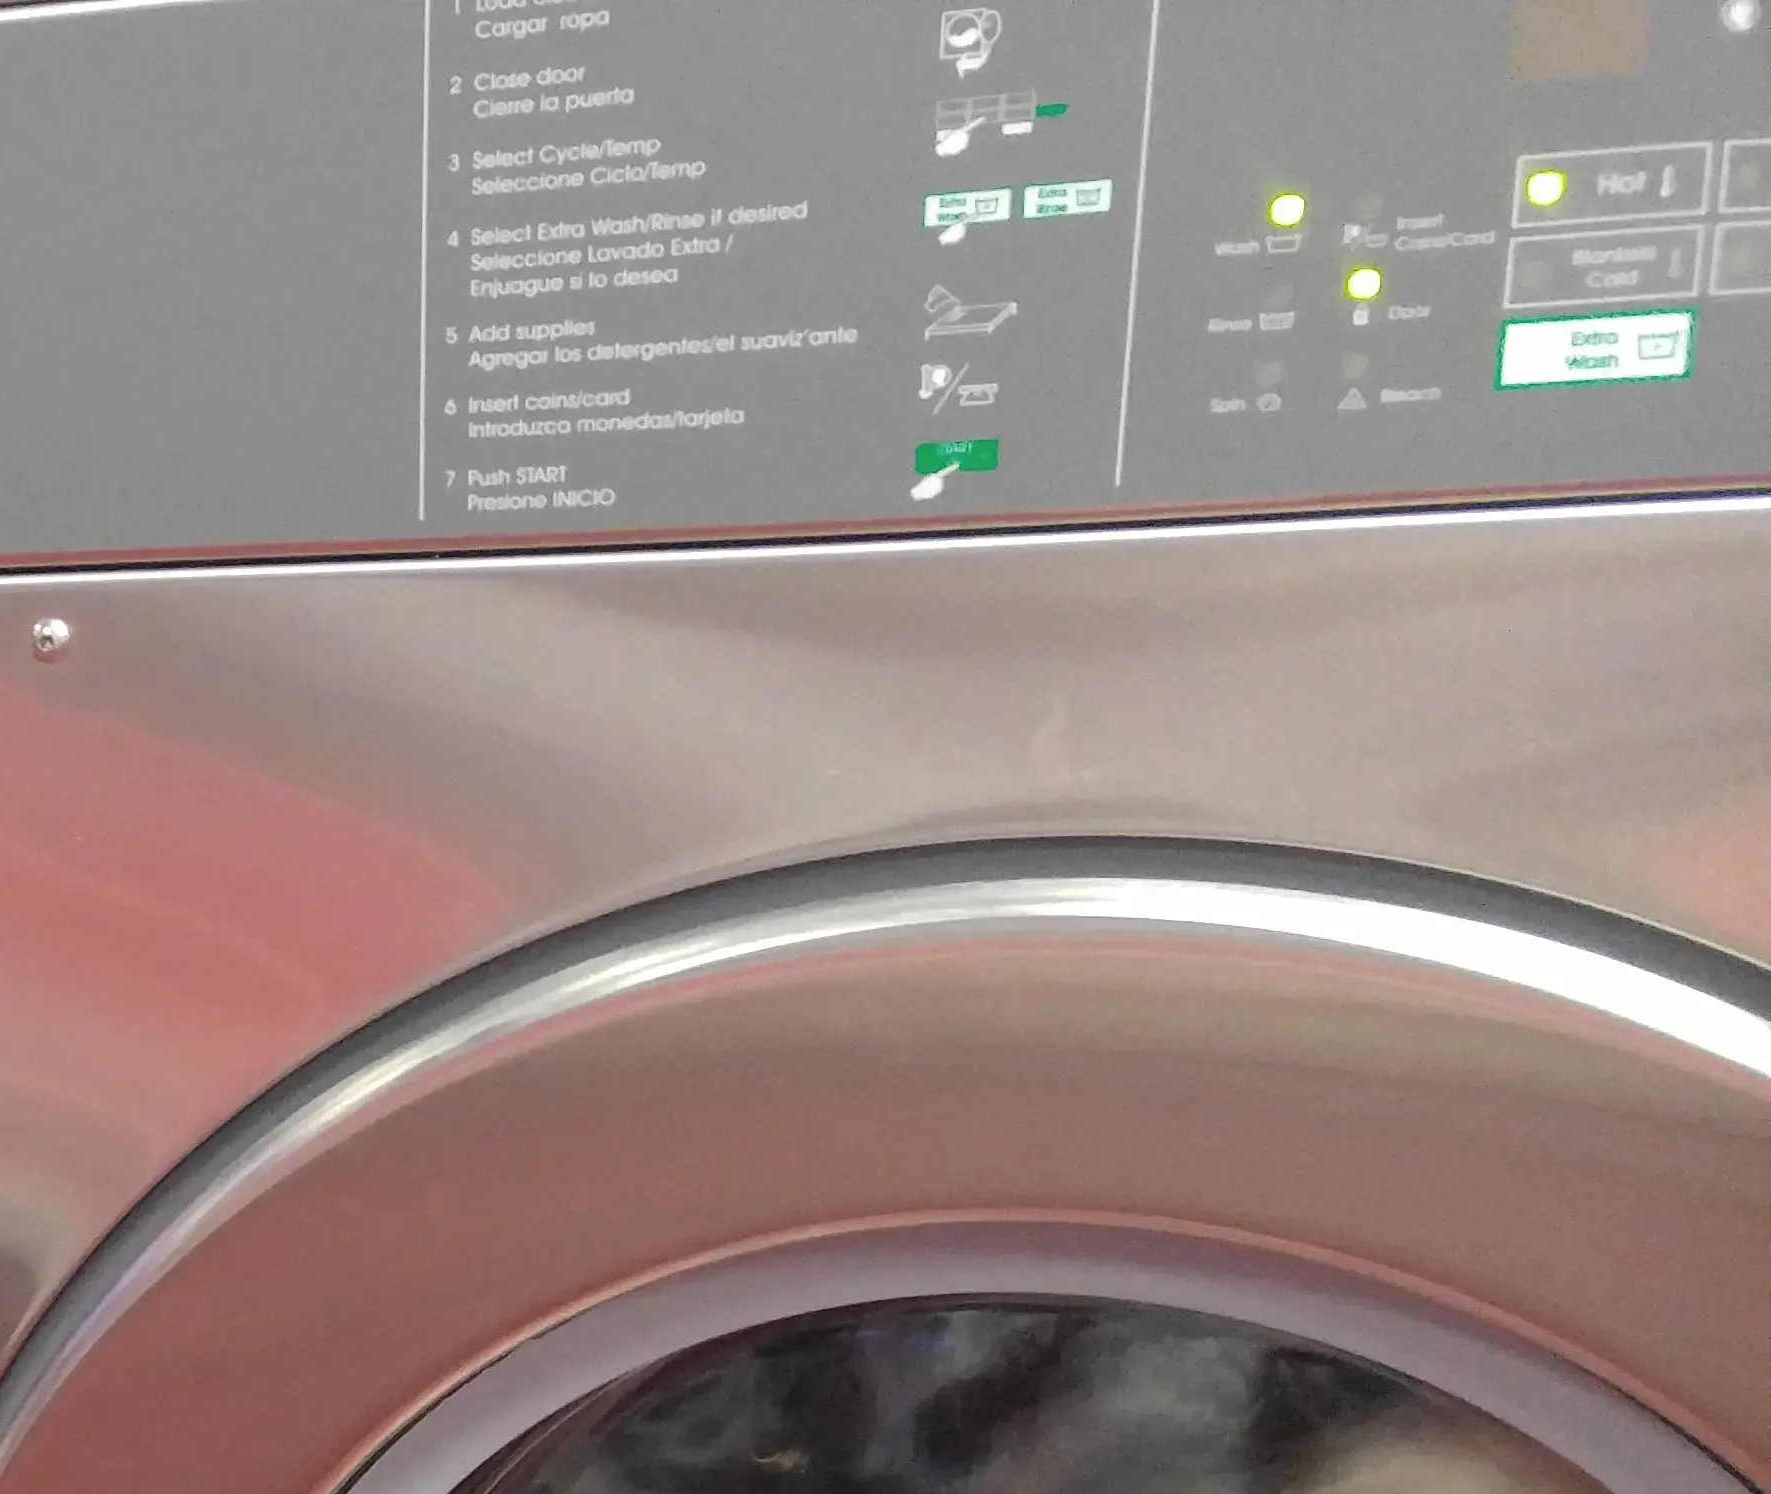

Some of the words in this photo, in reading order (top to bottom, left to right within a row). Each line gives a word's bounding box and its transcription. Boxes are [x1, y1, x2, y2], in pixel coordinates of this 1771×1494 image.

[475, 14, 547, 43] Cargar
[559, 9, 609, 32] ropa
[449, 75, 461, 94] 2
[473, 68, 531, 91] Close
[536, 63, 585, 86] door
[473, 94, 534, 118] Cierre
[540, 92, 559, 112] la
[564, 84, 634, 112] puerta
[448, 153, 459, 171] 3
[472, 145, 533, 170] Select
[539, 134, 661, 166] Cycle/Temp
[472, 168, 584, 196] Seleccione
[589, 156, 707, 187] Ciclo/Temp
[1597, 171, 1646, 196] Hot
[447, 230, 458, 247] 4
[471, 223, 531, 246] Select
[537, 219, 585, 241] Extra
[590, 209, 705, 237] Wash/Rinse
[710, 207, 722, 226] if
[727, 200, 808, 225] desired
[470, 245, 581, 272] Seleccione
[587, 239, 664, 263] Lavado
[670, 234, 720, 256] Extra
[470, 273, 564, 301] Enjuague
[588, 270, 607, 288] lo
[613, 264, 678, 287] desea
[445, 326, 457, 343] 5
[468, 323, 510, 343] Add
[515, 317, 595, 342] supplies
[1571, 331, 1619, 346] Extra
[468, 345, 548, 372] Agregar
[554, 344, 582, 363] los
[586, 334, 734, 364] detergentes/el
[1565, 354, 1620, 371] Wash
[444, 398, 456, 415] 6
[468, 394, 518, 414] Insert
[525, 387, 630, 411] coins/card
[576, 406, 744, 435] monedas/tarjeta
[445, 470, 455, 487] 7
[468, 467, 510, 486] Push
[516, 464, 567, 485] START
[467, 490, 547, 512] Presione
[553, 487, 616, 508] INICIO
